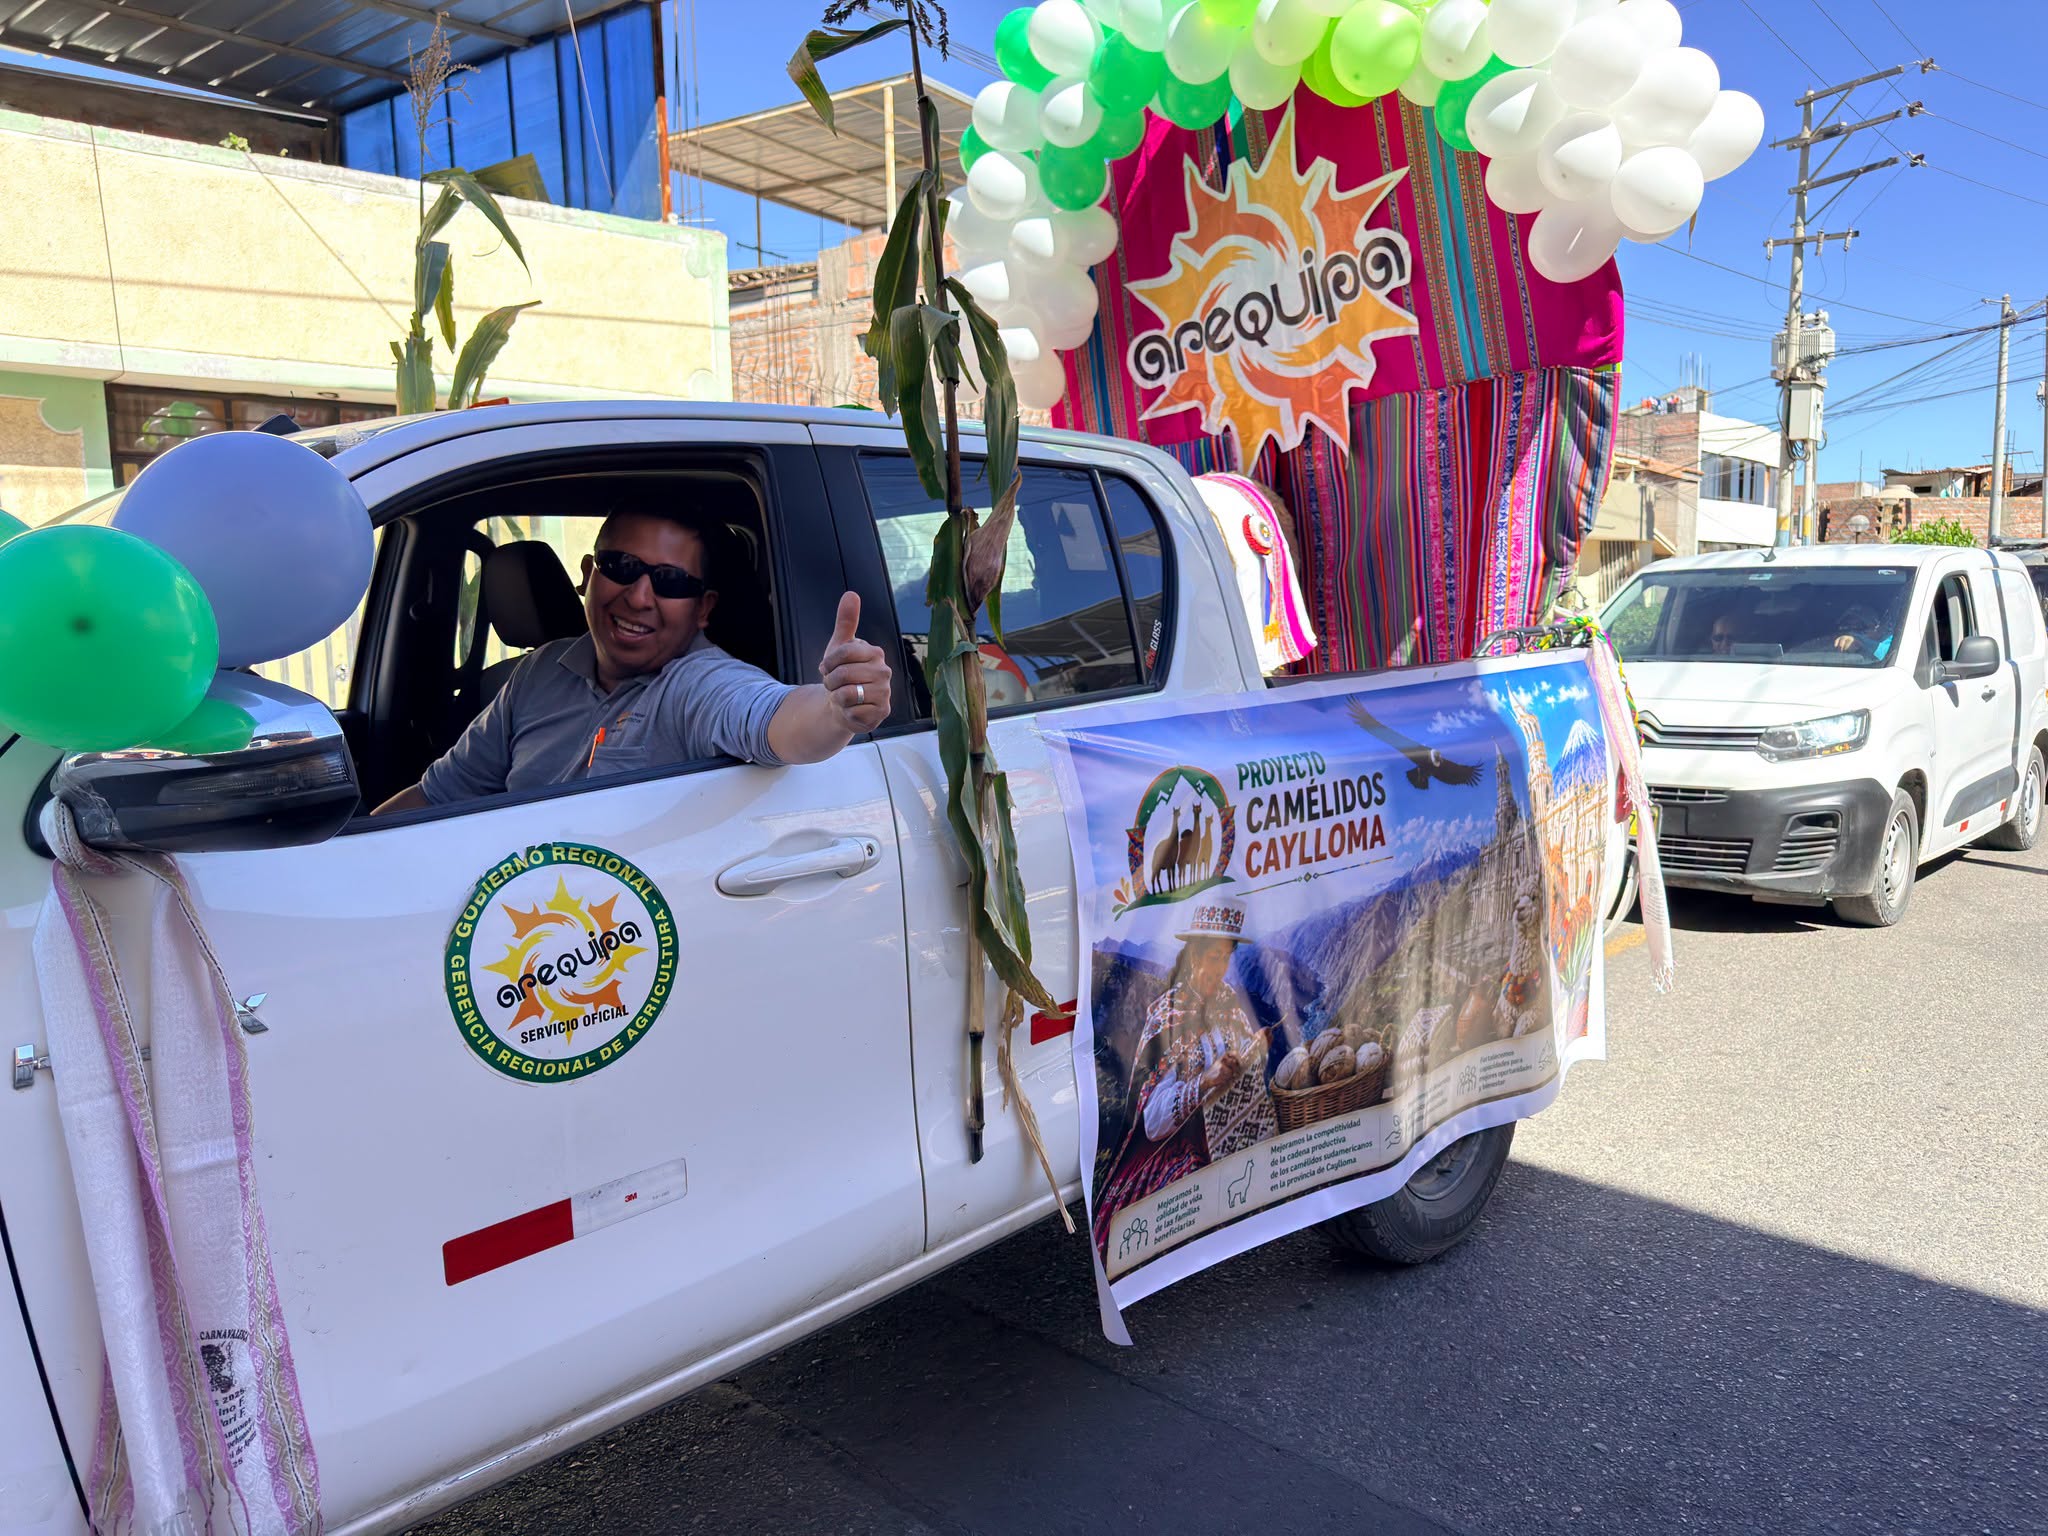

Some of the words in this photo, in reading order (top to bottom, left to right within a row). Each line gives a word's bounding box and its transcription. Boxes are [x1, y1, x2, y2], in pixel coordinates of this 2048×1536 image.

[1236, 751, 1326, 791] PROYECTO
[1246, 772, 1386, 833] CAMÉLIDOS
[1245, 814, 1386, 878] CAYLLOMA
[552, 847, 656, 904] REGIONAL
[451, 954, 495, 1055] GERENCIA
[496, 1048, 596, 1076] REGIONAL
[600, 1037, 625, 1061] DE
[626, 907, 674, 1039] AGRICULTURA
[520, 1017, 579, 1044] SERVICIO
[582, 1004, 629, 1027] OFICIAL
[1270, 1136, 1305, 1154] Mejoramos
[1306, 1133, 1312, 1142] la
[1313, 1118, 1361, 1139] competitividad
[1270, 1158, 1278, 1167] de
[1280, 1154, 1286, 1163] la
[1287, 1147, 1310, 1161] cadena
[1311, 1136, 1346, 1155] productiva
[1270, 1171, 1278, 1180] de
[1280, 1167, 1289, 1176] los
[1290, 1154, 1322, 1172] camélidos
[1323, 1141, 1373, 1160] sudamericanos
[1270, 1183, 1278, 1192] en
[1280, 1179, 1286, 1188] la
[1286, 1170, 1315, 1187] provincia
[1316, 1165, 1325, 1174] de
[1326, 1157, 1357, 1171] Caylloma
[624, 1192, 637, 1202] 3M
[1156, 1203, 1179, 1222] calidad
[1180, 1200, 1188, 1210] de
[1189, 1194, 1202, 1205] vida
[1157, 1188, 1192, 1211] Mejoramos
[1193, 1184, 1199, 1192] la
[1154, 1218, 1195, 1245] beneficiarias
[1155, 1224, 1163, 1233] de
[1164, 1219, 1173, 1228] las
[1175, 1205, 1200, 1223] familias
[222, 1389, 245, 1404] 2025
